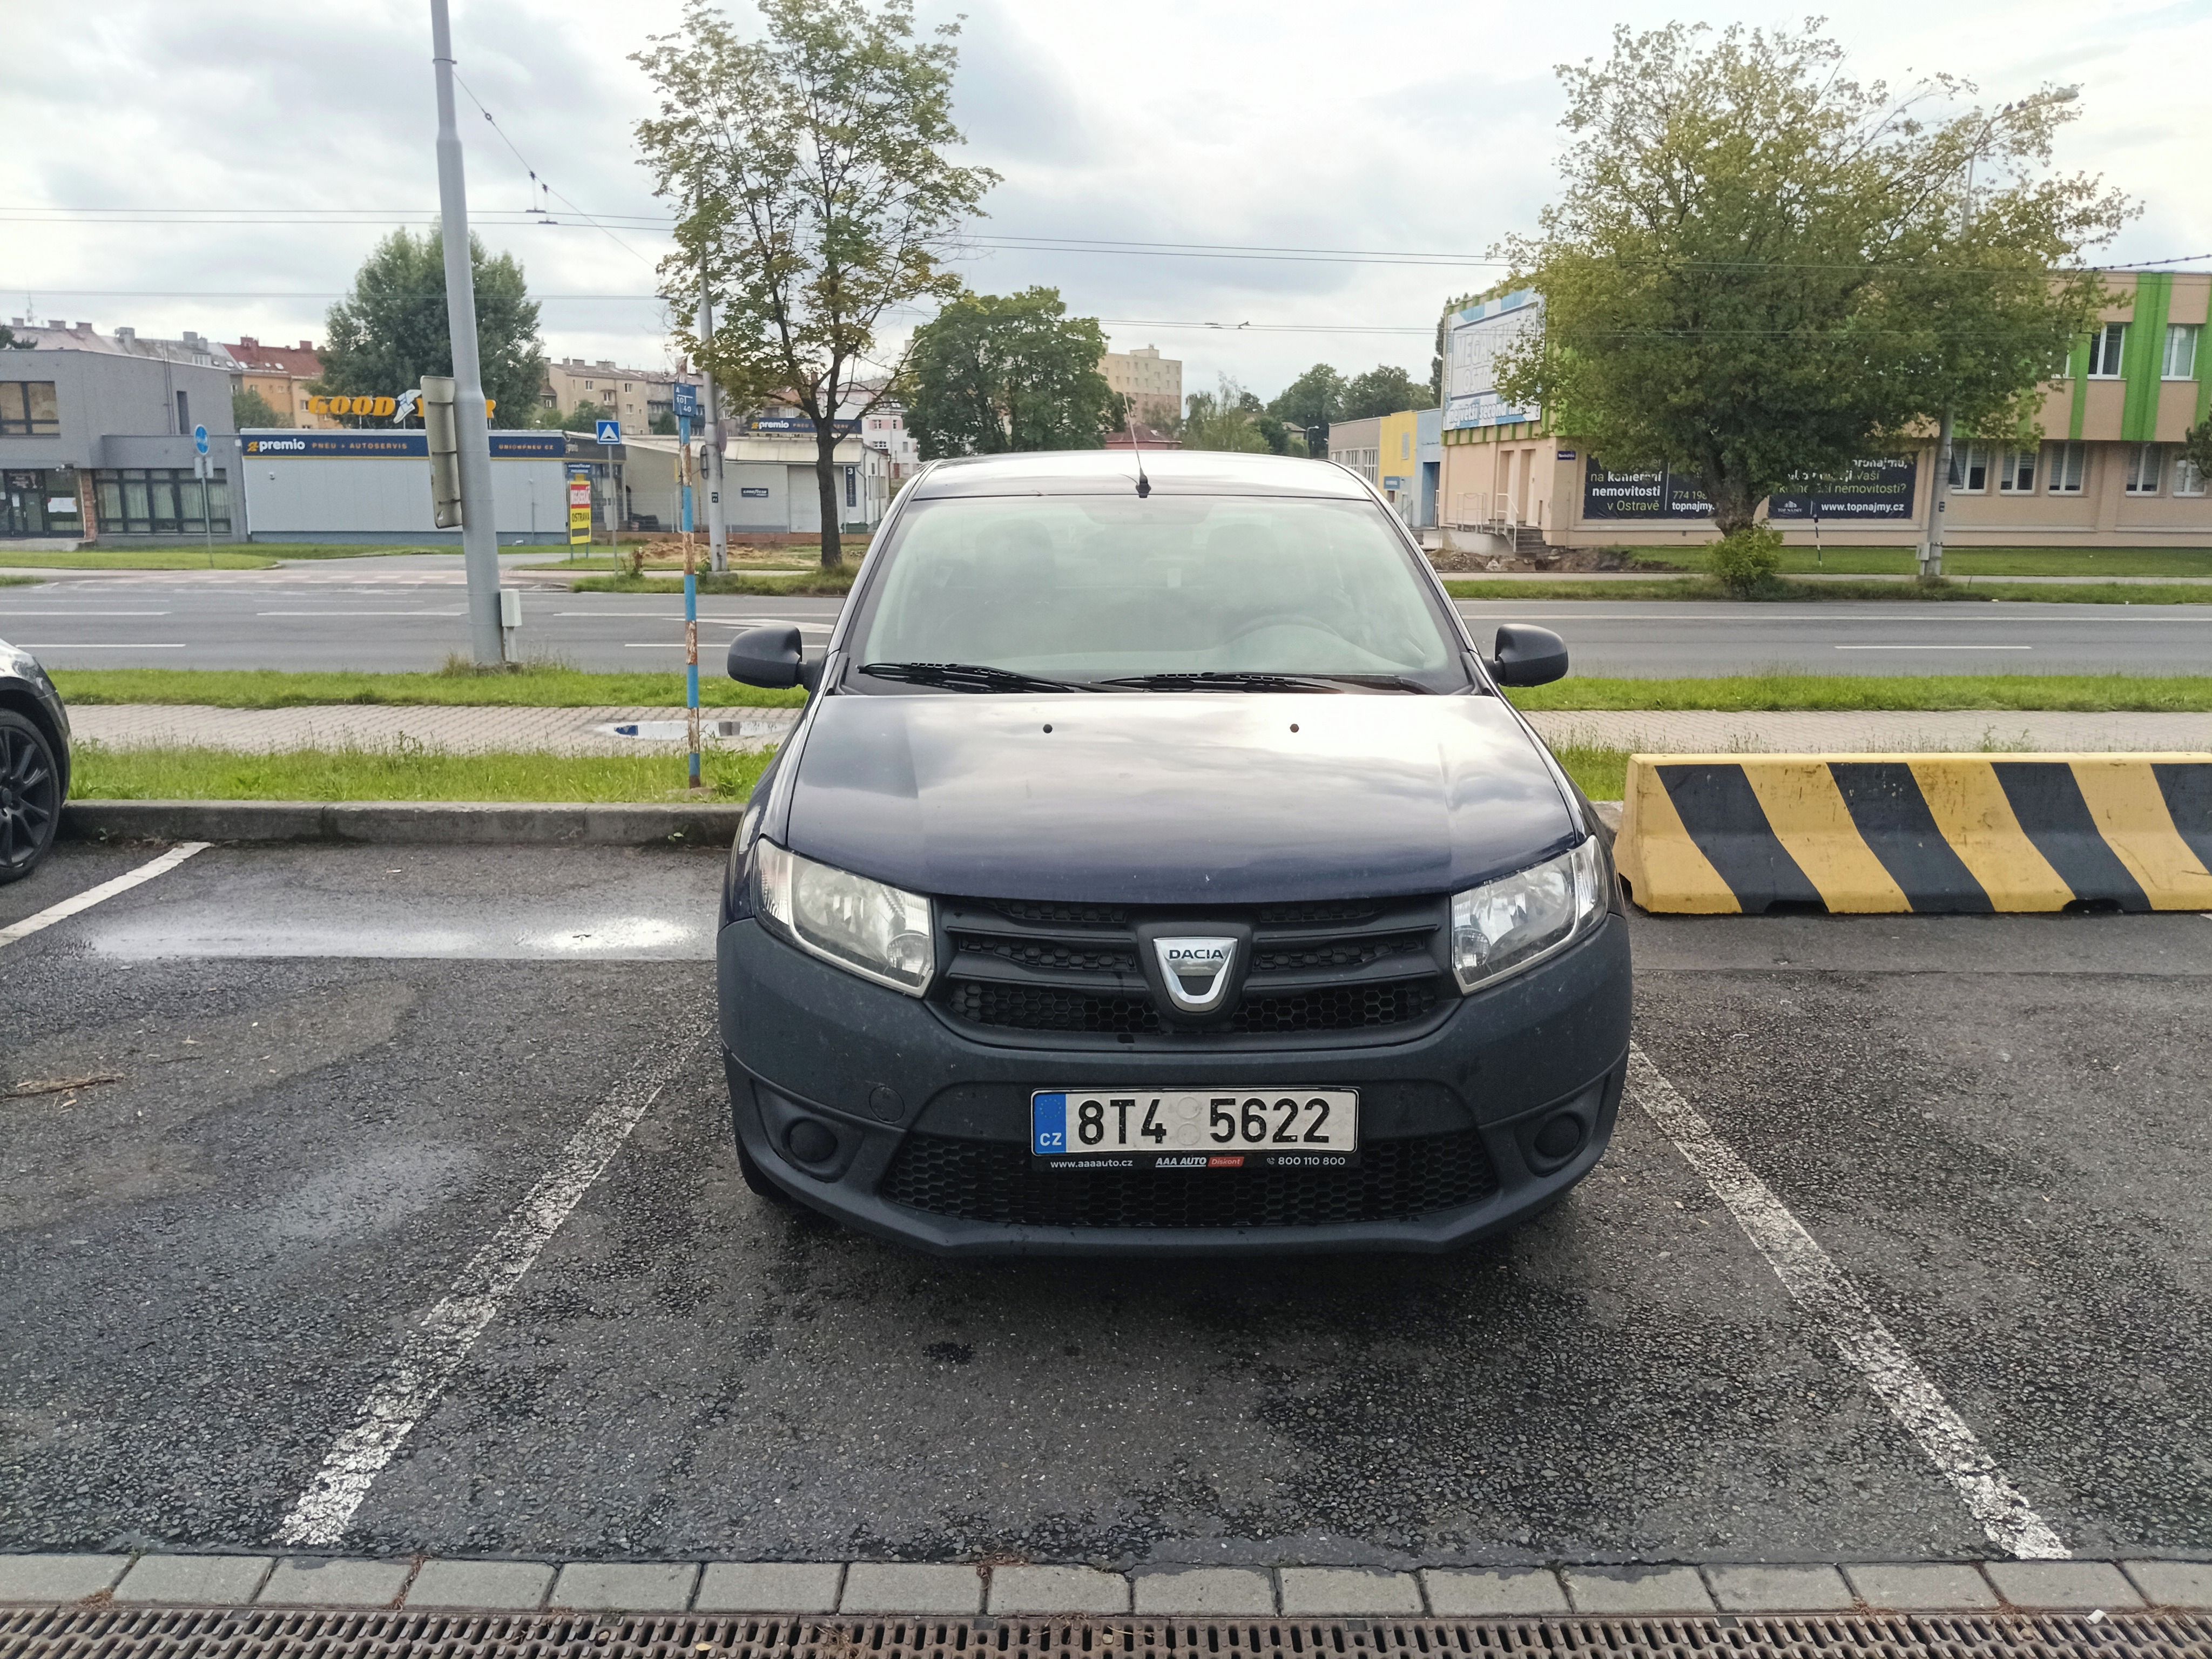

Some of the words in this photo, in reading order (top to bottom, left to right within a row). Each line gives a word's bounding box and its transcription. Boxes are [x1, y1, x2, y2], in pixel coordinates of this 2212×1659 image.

[308, 395, 396, 416] GOOD
[758, 420, 790, 430] premio
[259, 438, 306, 453] premio
[847, 467, 853, 475] 3
[1590, 473, 1604, 482] na
[1592, 485, 1661, 496] nemovitosti
[1834, 482, 1907, 494] nemovitosti?
[1673, 490, 1690, 500] 774
[1607, 502, 1614, 511] v
[1616, 500, 1660, 511] Ostravě
[1671, 501, 1715, 512] topnajmy.
[1821, 502, 1905, 513] www.topnajmy.cz
[571, 512, 590, 522] OSTRAVA
[1169, 949, 1224, 959] DACIA
[1078, 1098, 1166, 1145] 8T4
[1210, 1097, 1330, 1143] 5622
[1040, 1132, 1062, 1146] CZ
[1050, 1159, 1133, 1168] www.aaaauto.cz
[1156, 1157, 1177, 1165] AAA
[1179, 1157, 1207, 1165] AUTO
[1278, 1157, 1301, 1165] 800
[1303, 1157, 1320, 1165] 110
[1323, 1157, 1346, 1165] 800
